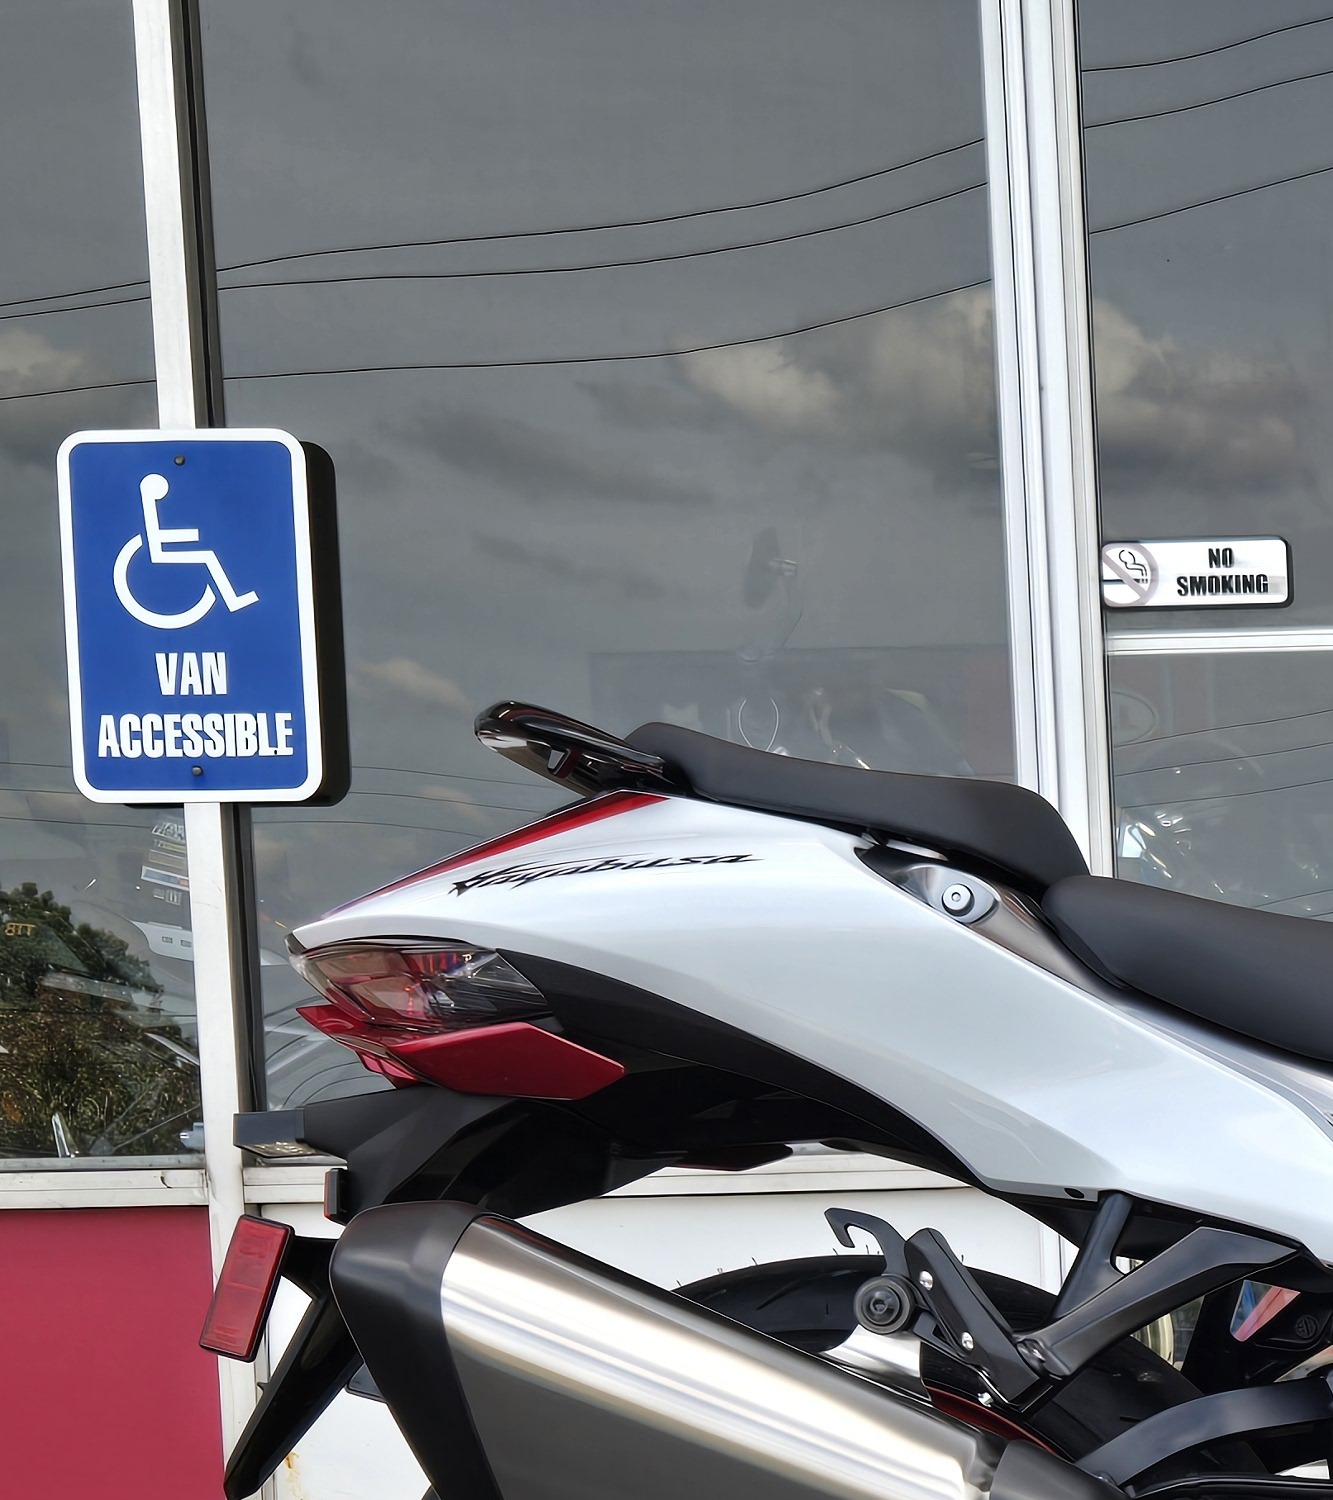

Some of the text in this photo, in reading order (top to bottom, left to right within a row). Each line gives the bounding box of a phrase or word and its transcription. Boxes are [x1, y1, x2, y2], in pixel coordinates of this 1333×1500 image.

[1207, 547, 1235, 569] NO
[1176, 573, 1269, 597] SMOKING
[154, 651, 228, 696] VAN
[97, 711, 294, 760] ACCESSIBLE
[447, 852, 765, 898] Hayabusa
